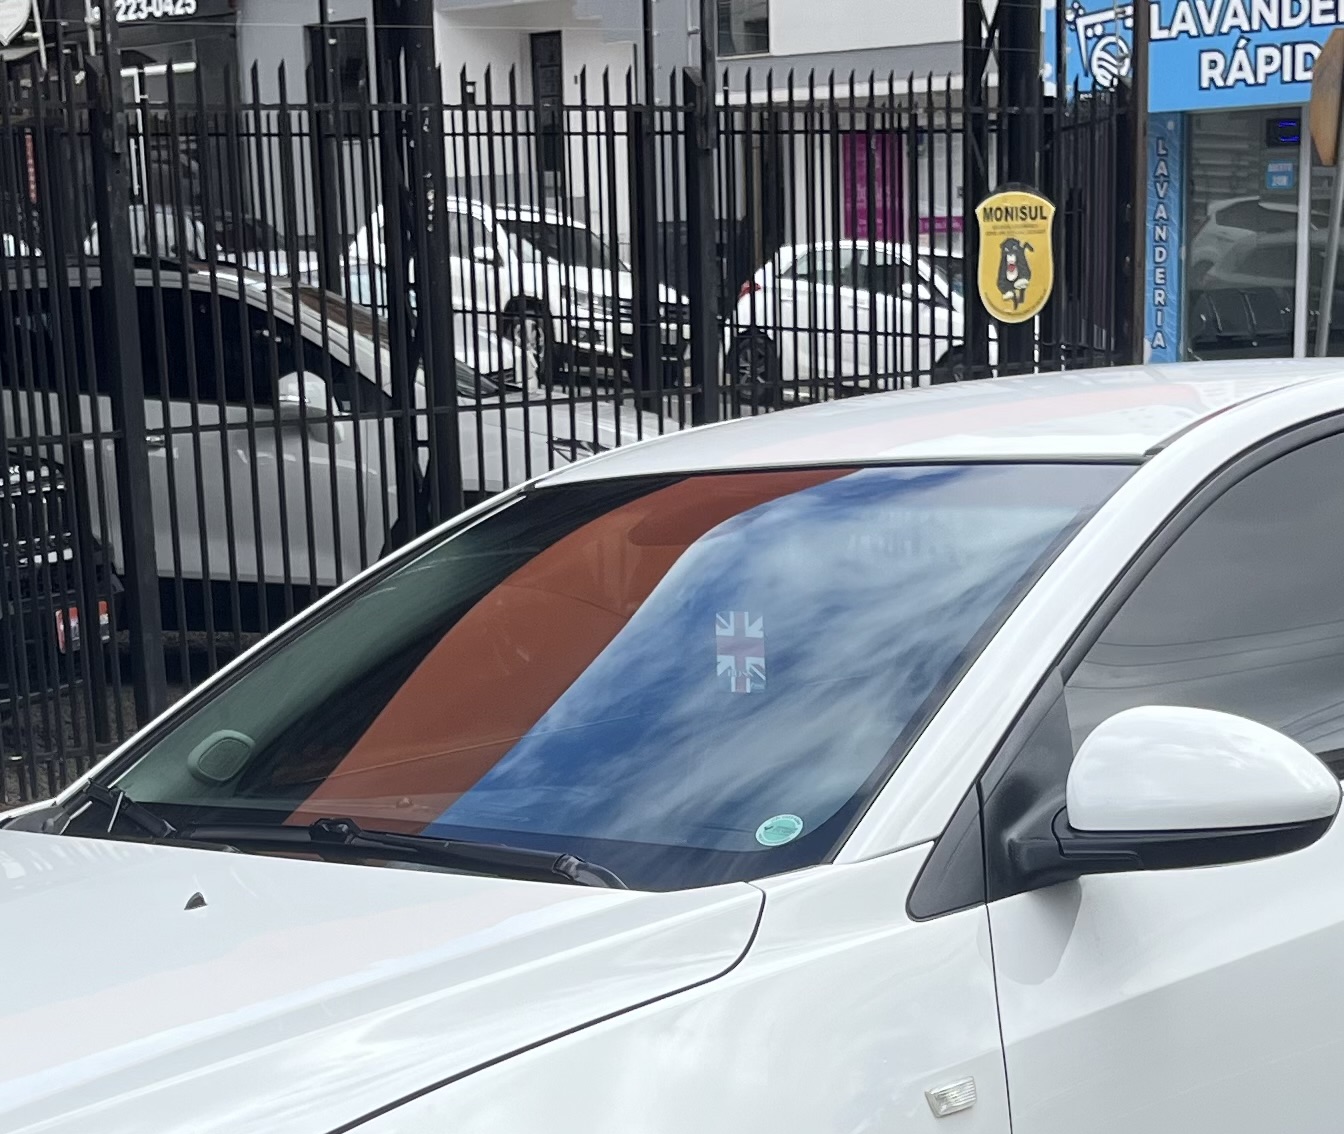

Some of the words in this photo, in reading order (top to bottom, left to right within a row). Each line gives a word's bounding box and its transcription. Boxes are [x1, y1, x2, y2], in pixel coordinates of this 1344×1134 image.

[1199, 36, 1323, 90] RÁPID
[982, 205, 1048, 223] MONISUL
[1152, 138, 1169, 350] LAVANDERIA
